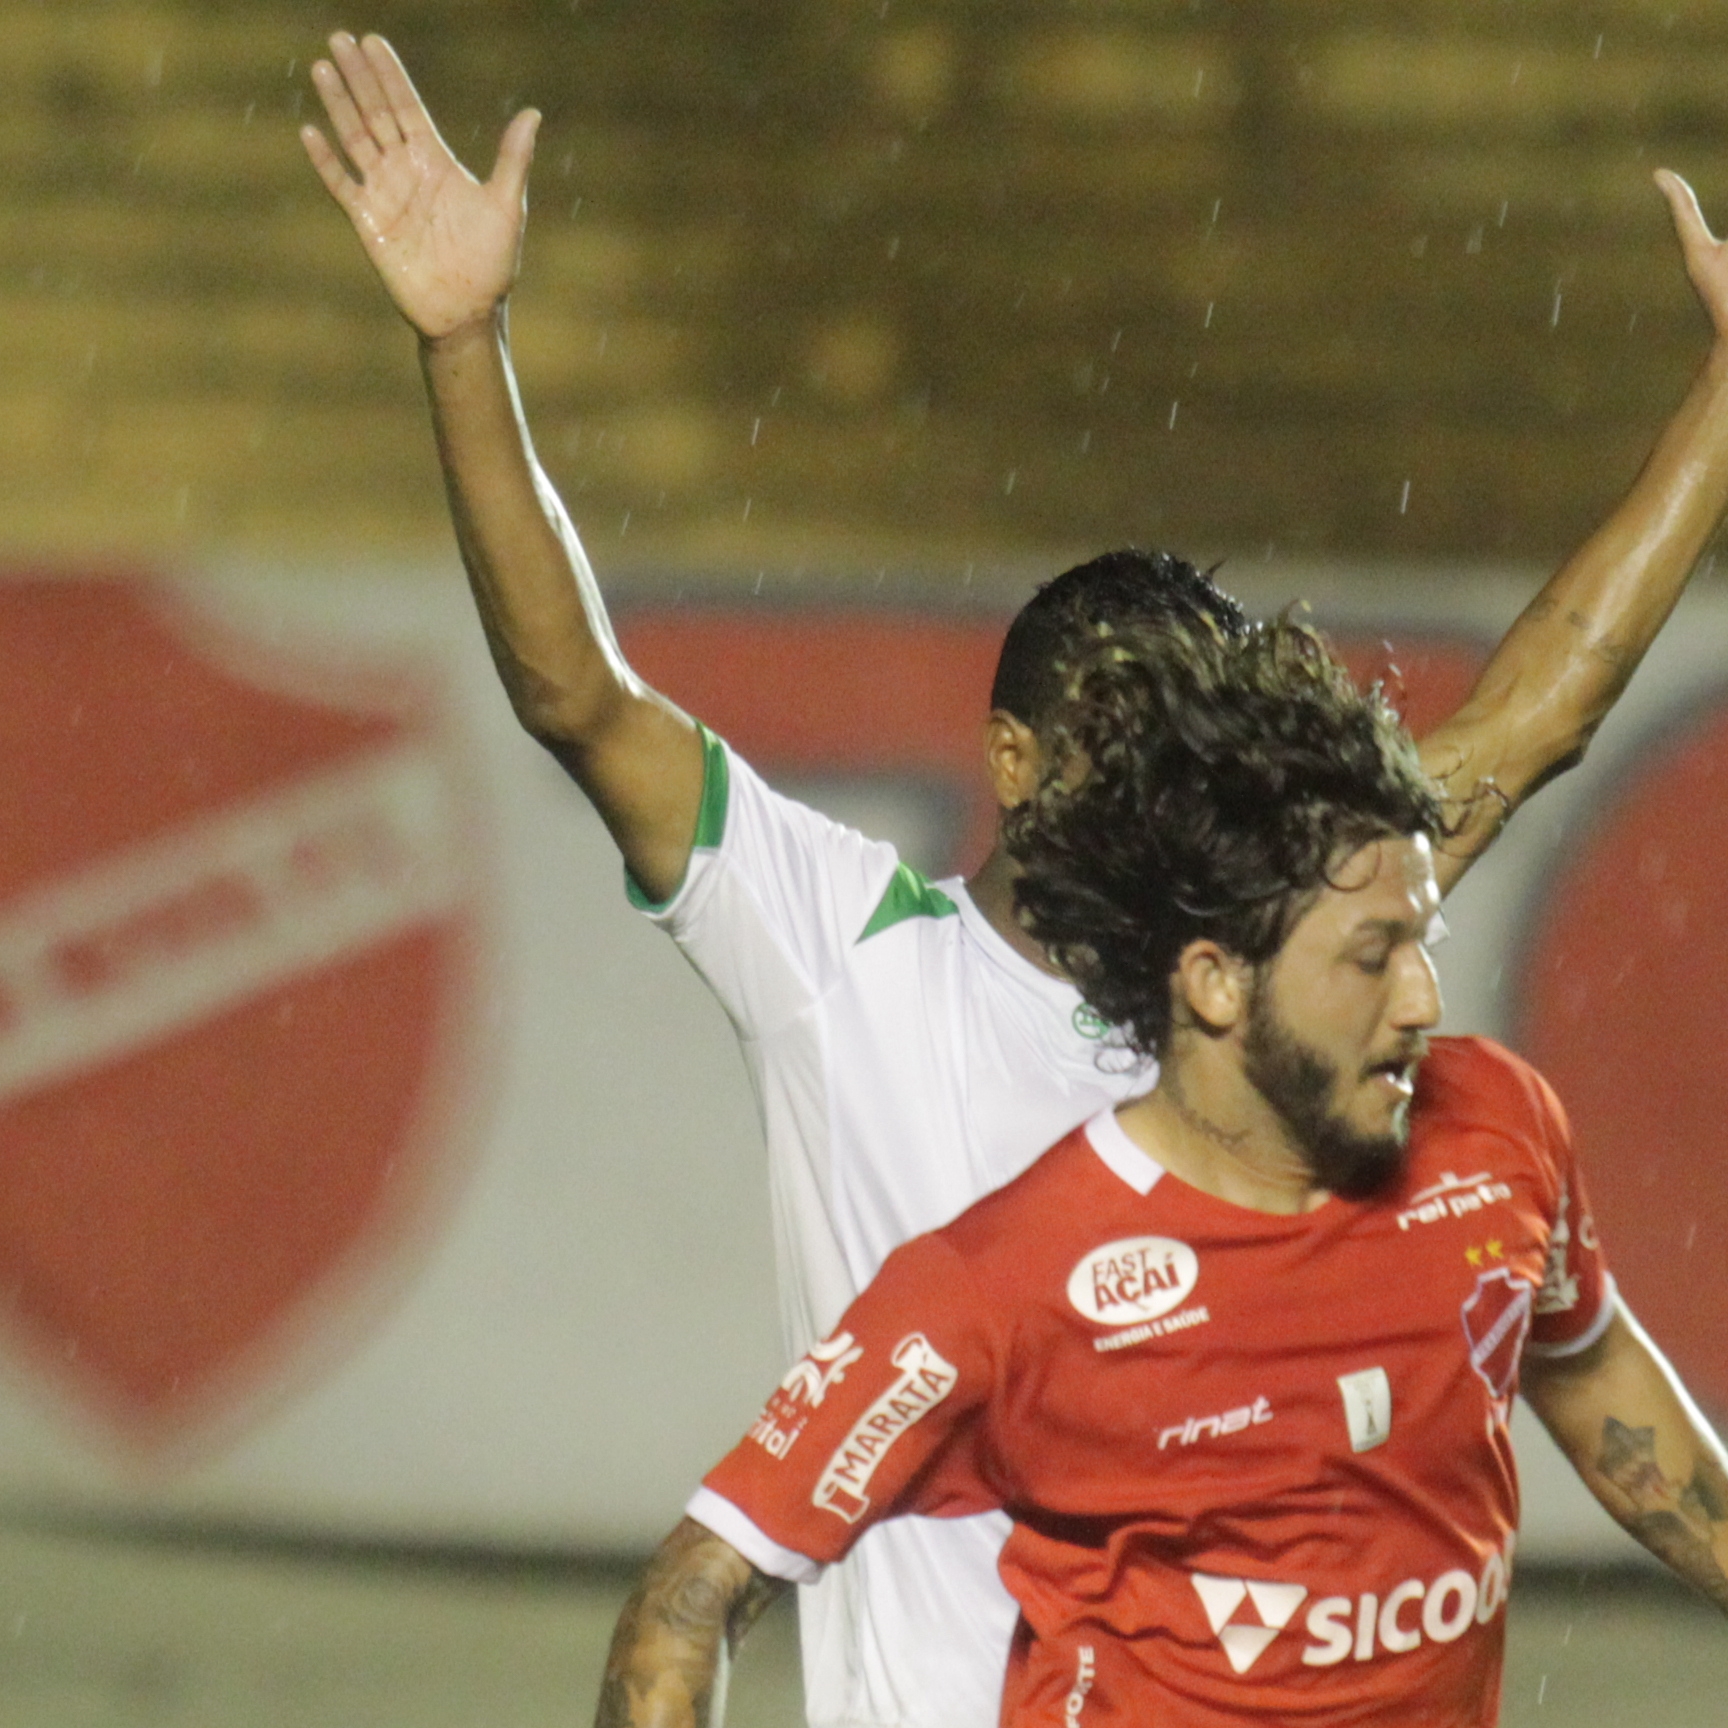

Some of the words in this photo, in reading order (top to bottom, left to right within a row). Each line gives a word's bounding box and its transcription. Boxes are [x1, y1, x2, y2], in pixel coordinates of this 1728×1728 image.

[1091, 1246, 1150, 1284] FAST
[1092, 1324, 1155, 1353] ENERGIA
[1157, 1394, 1274, 1451] rinat
[1301, 1532, 1515, 1668] SICOO
